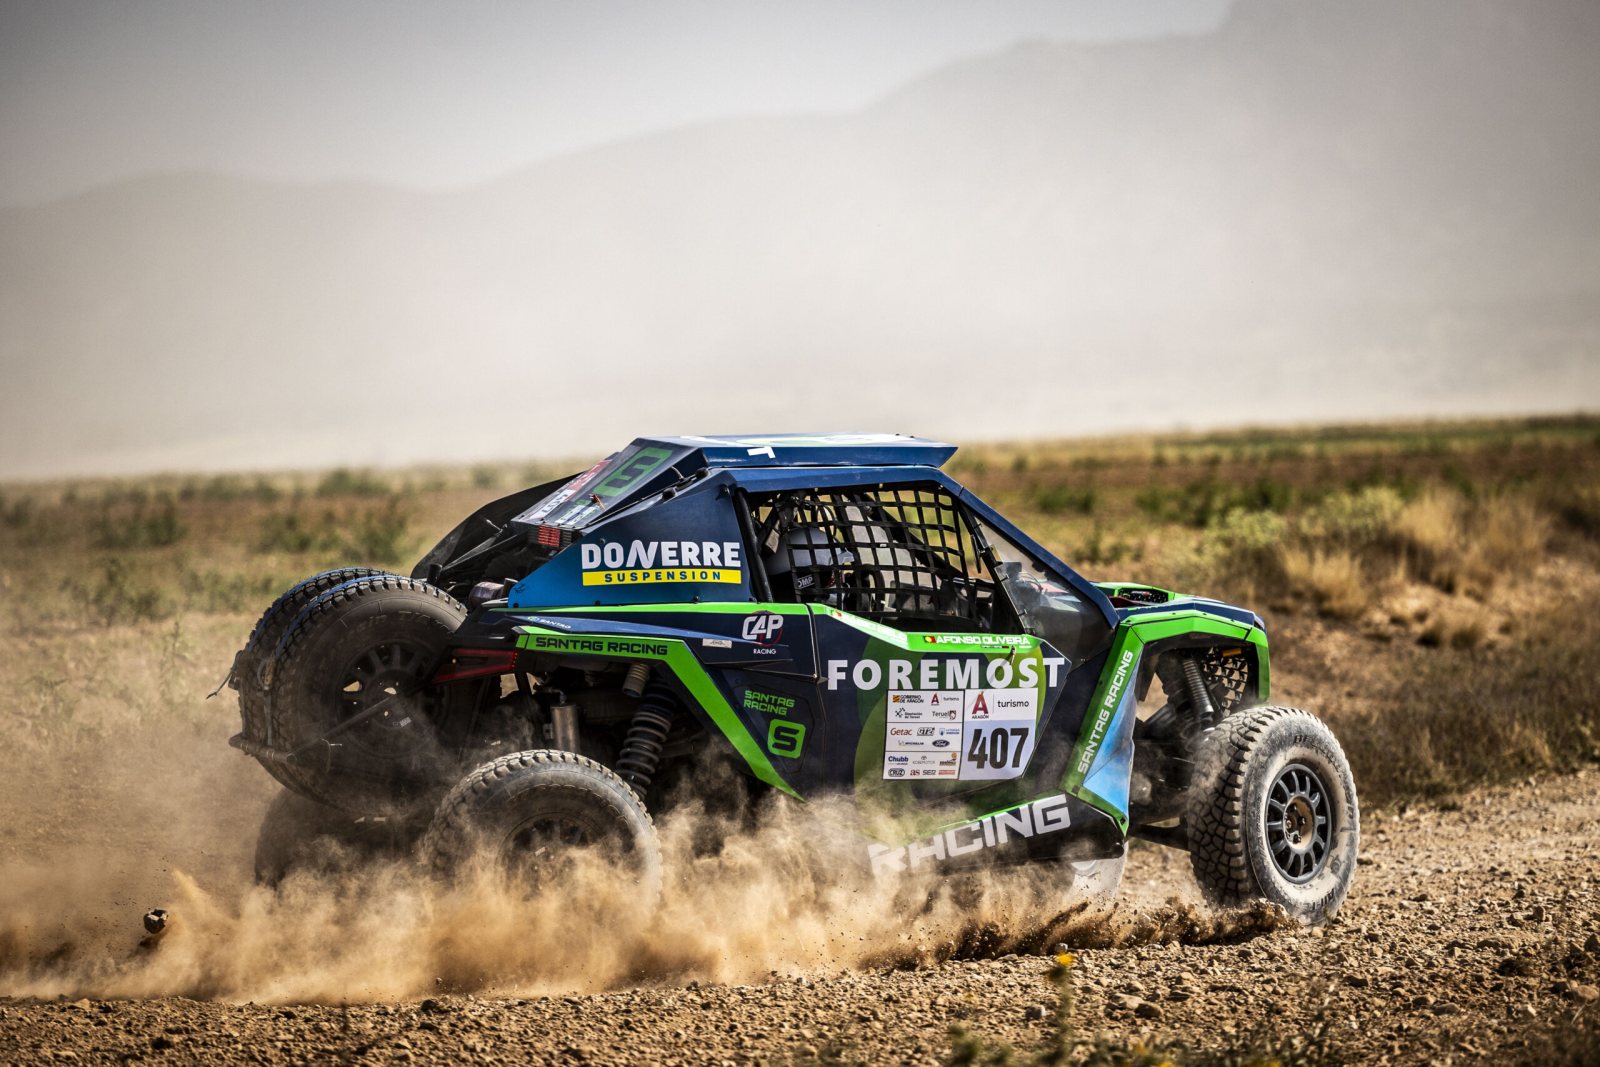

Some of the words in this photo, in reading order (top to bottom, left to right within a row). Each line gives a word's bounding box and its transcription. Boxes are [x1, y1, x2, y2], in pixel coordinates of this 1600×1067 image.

[605, 571, 721, 583] SUSPENSION
[536, 636, 603, 652] SANTAG
[607, 642, 668, 656] RACING
[936, 635, 980, 645] AFONSO
[981, 636, 1031, 645] OLIVEIRA
[828, 657, 1064, 690] FOREMOST
[744, 690, 795, 708] SANTAG
[997, 699, 1029, 708] turismo
[743, 700, 787, 716] RACING
[1077, 708, 1110, 774] SANTAG
[1104, 649, 1134, 708] RACING
[890, 728, 912, 736] Getac
[967, 727, 1029, 769] 407
